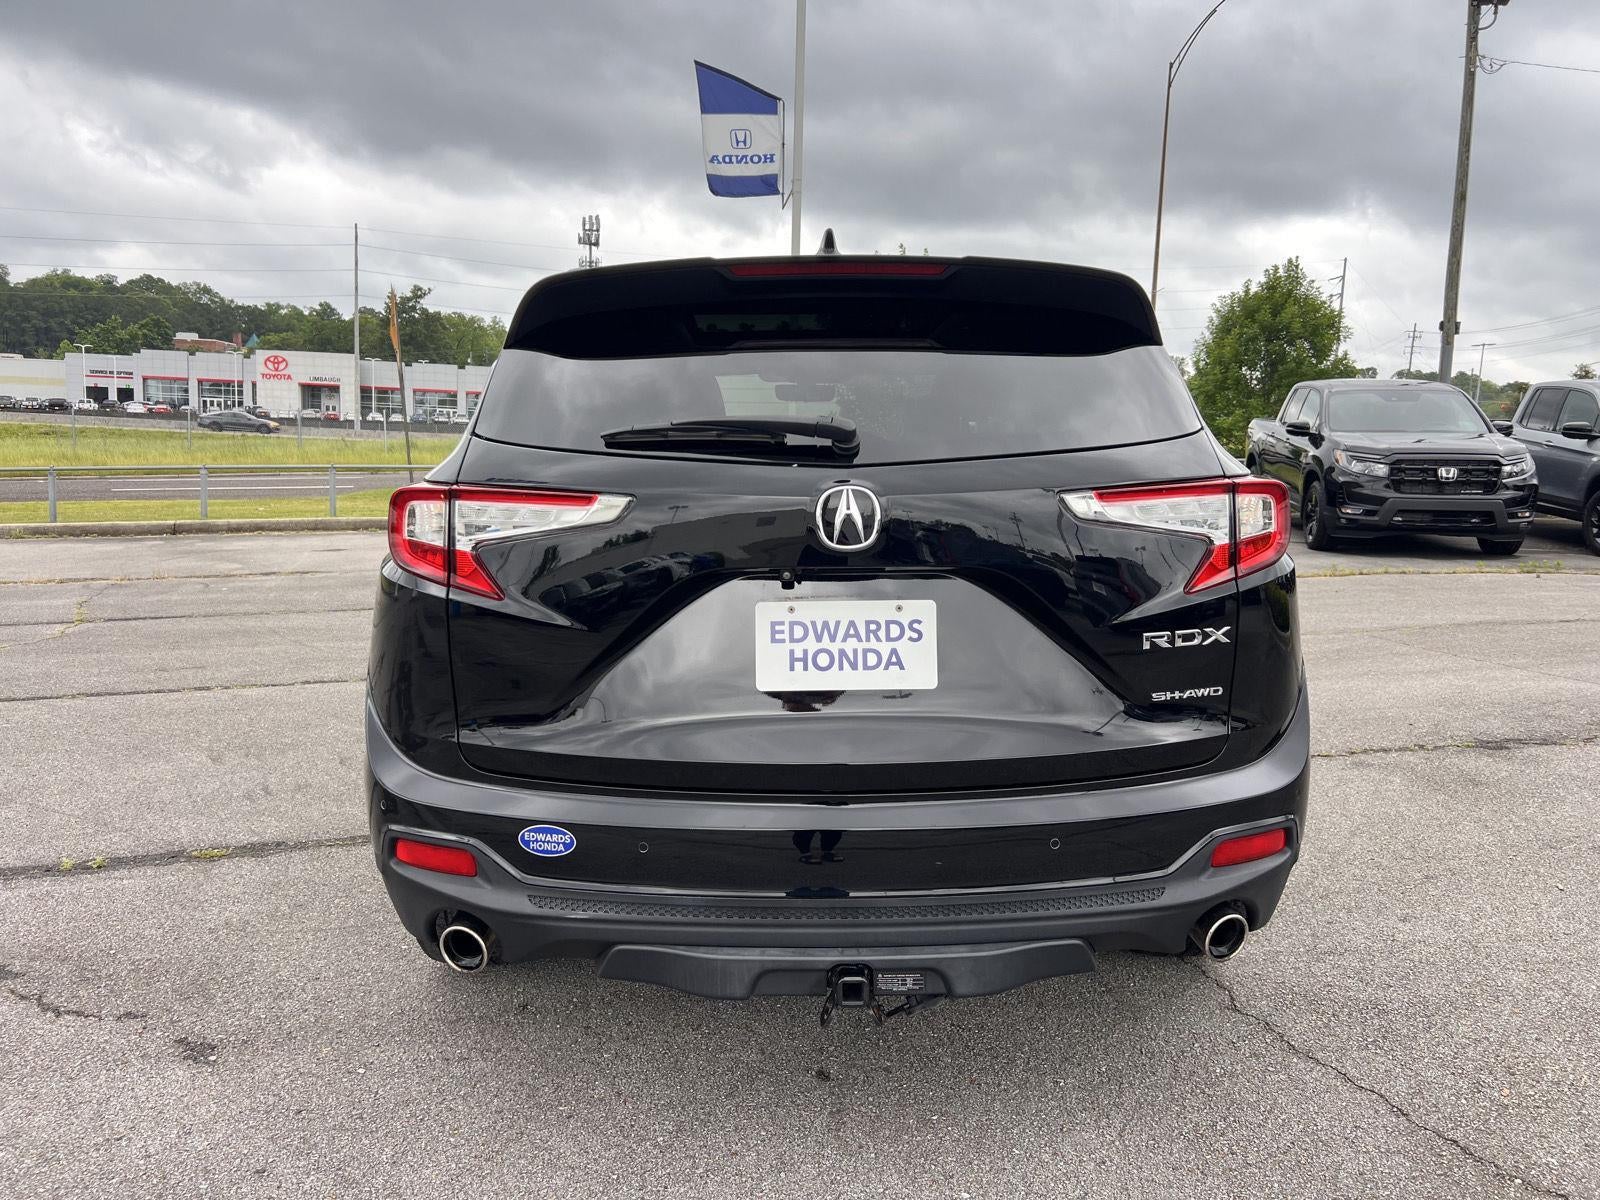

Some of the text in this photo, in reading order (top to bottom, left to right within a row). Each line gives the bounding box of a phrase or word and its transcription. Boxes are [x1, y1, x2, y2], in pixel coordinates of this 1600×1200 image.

[261, 373, 292, 381] TOYOTA
[769, 618, 924, 644] EDWARDS
[1142, 626, 1232, 650] RDX
[788, 647, 906, 672] HONDA
[1151, 686, 1223, 701] SH-AWD
[524, 832, 571, 843] EDWARDS
[530, 842, 565, 851] HONDA
